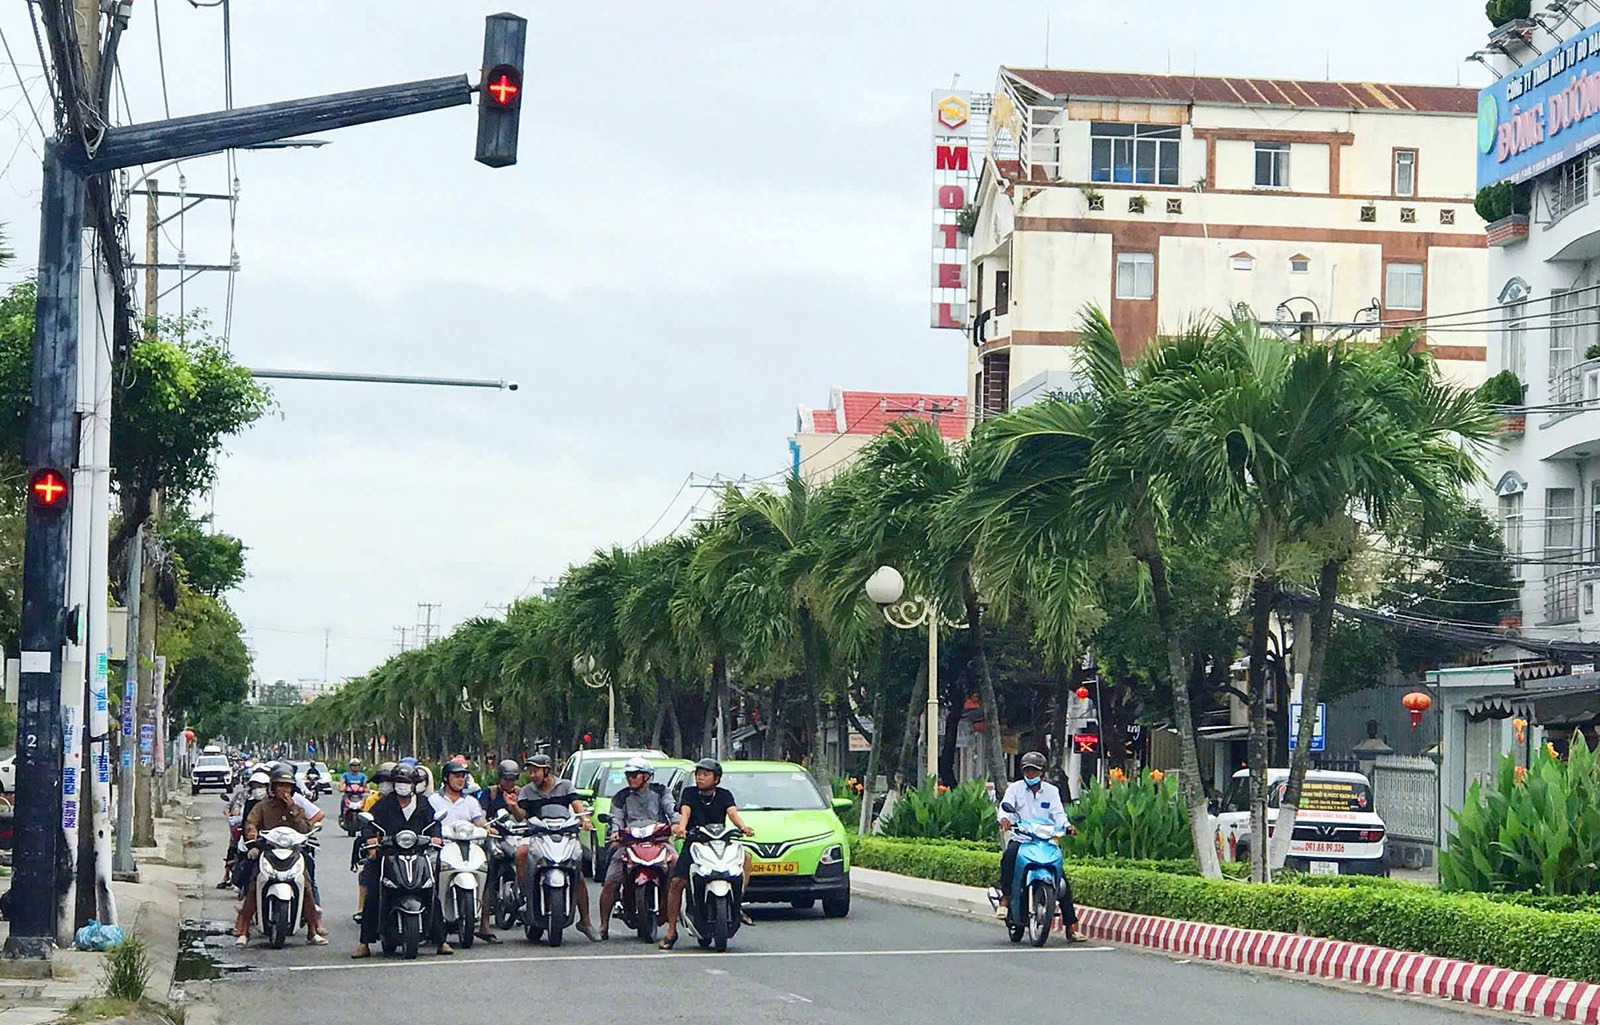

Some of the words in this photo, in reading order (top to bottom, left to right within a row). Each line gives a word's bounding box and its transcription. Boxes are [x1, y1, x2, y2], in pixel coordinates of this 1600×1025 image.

[1524, 70, 1533, 92] TY
[936, 145, 969, 327] MOTEL
[27, 734, 37, 748] 2
